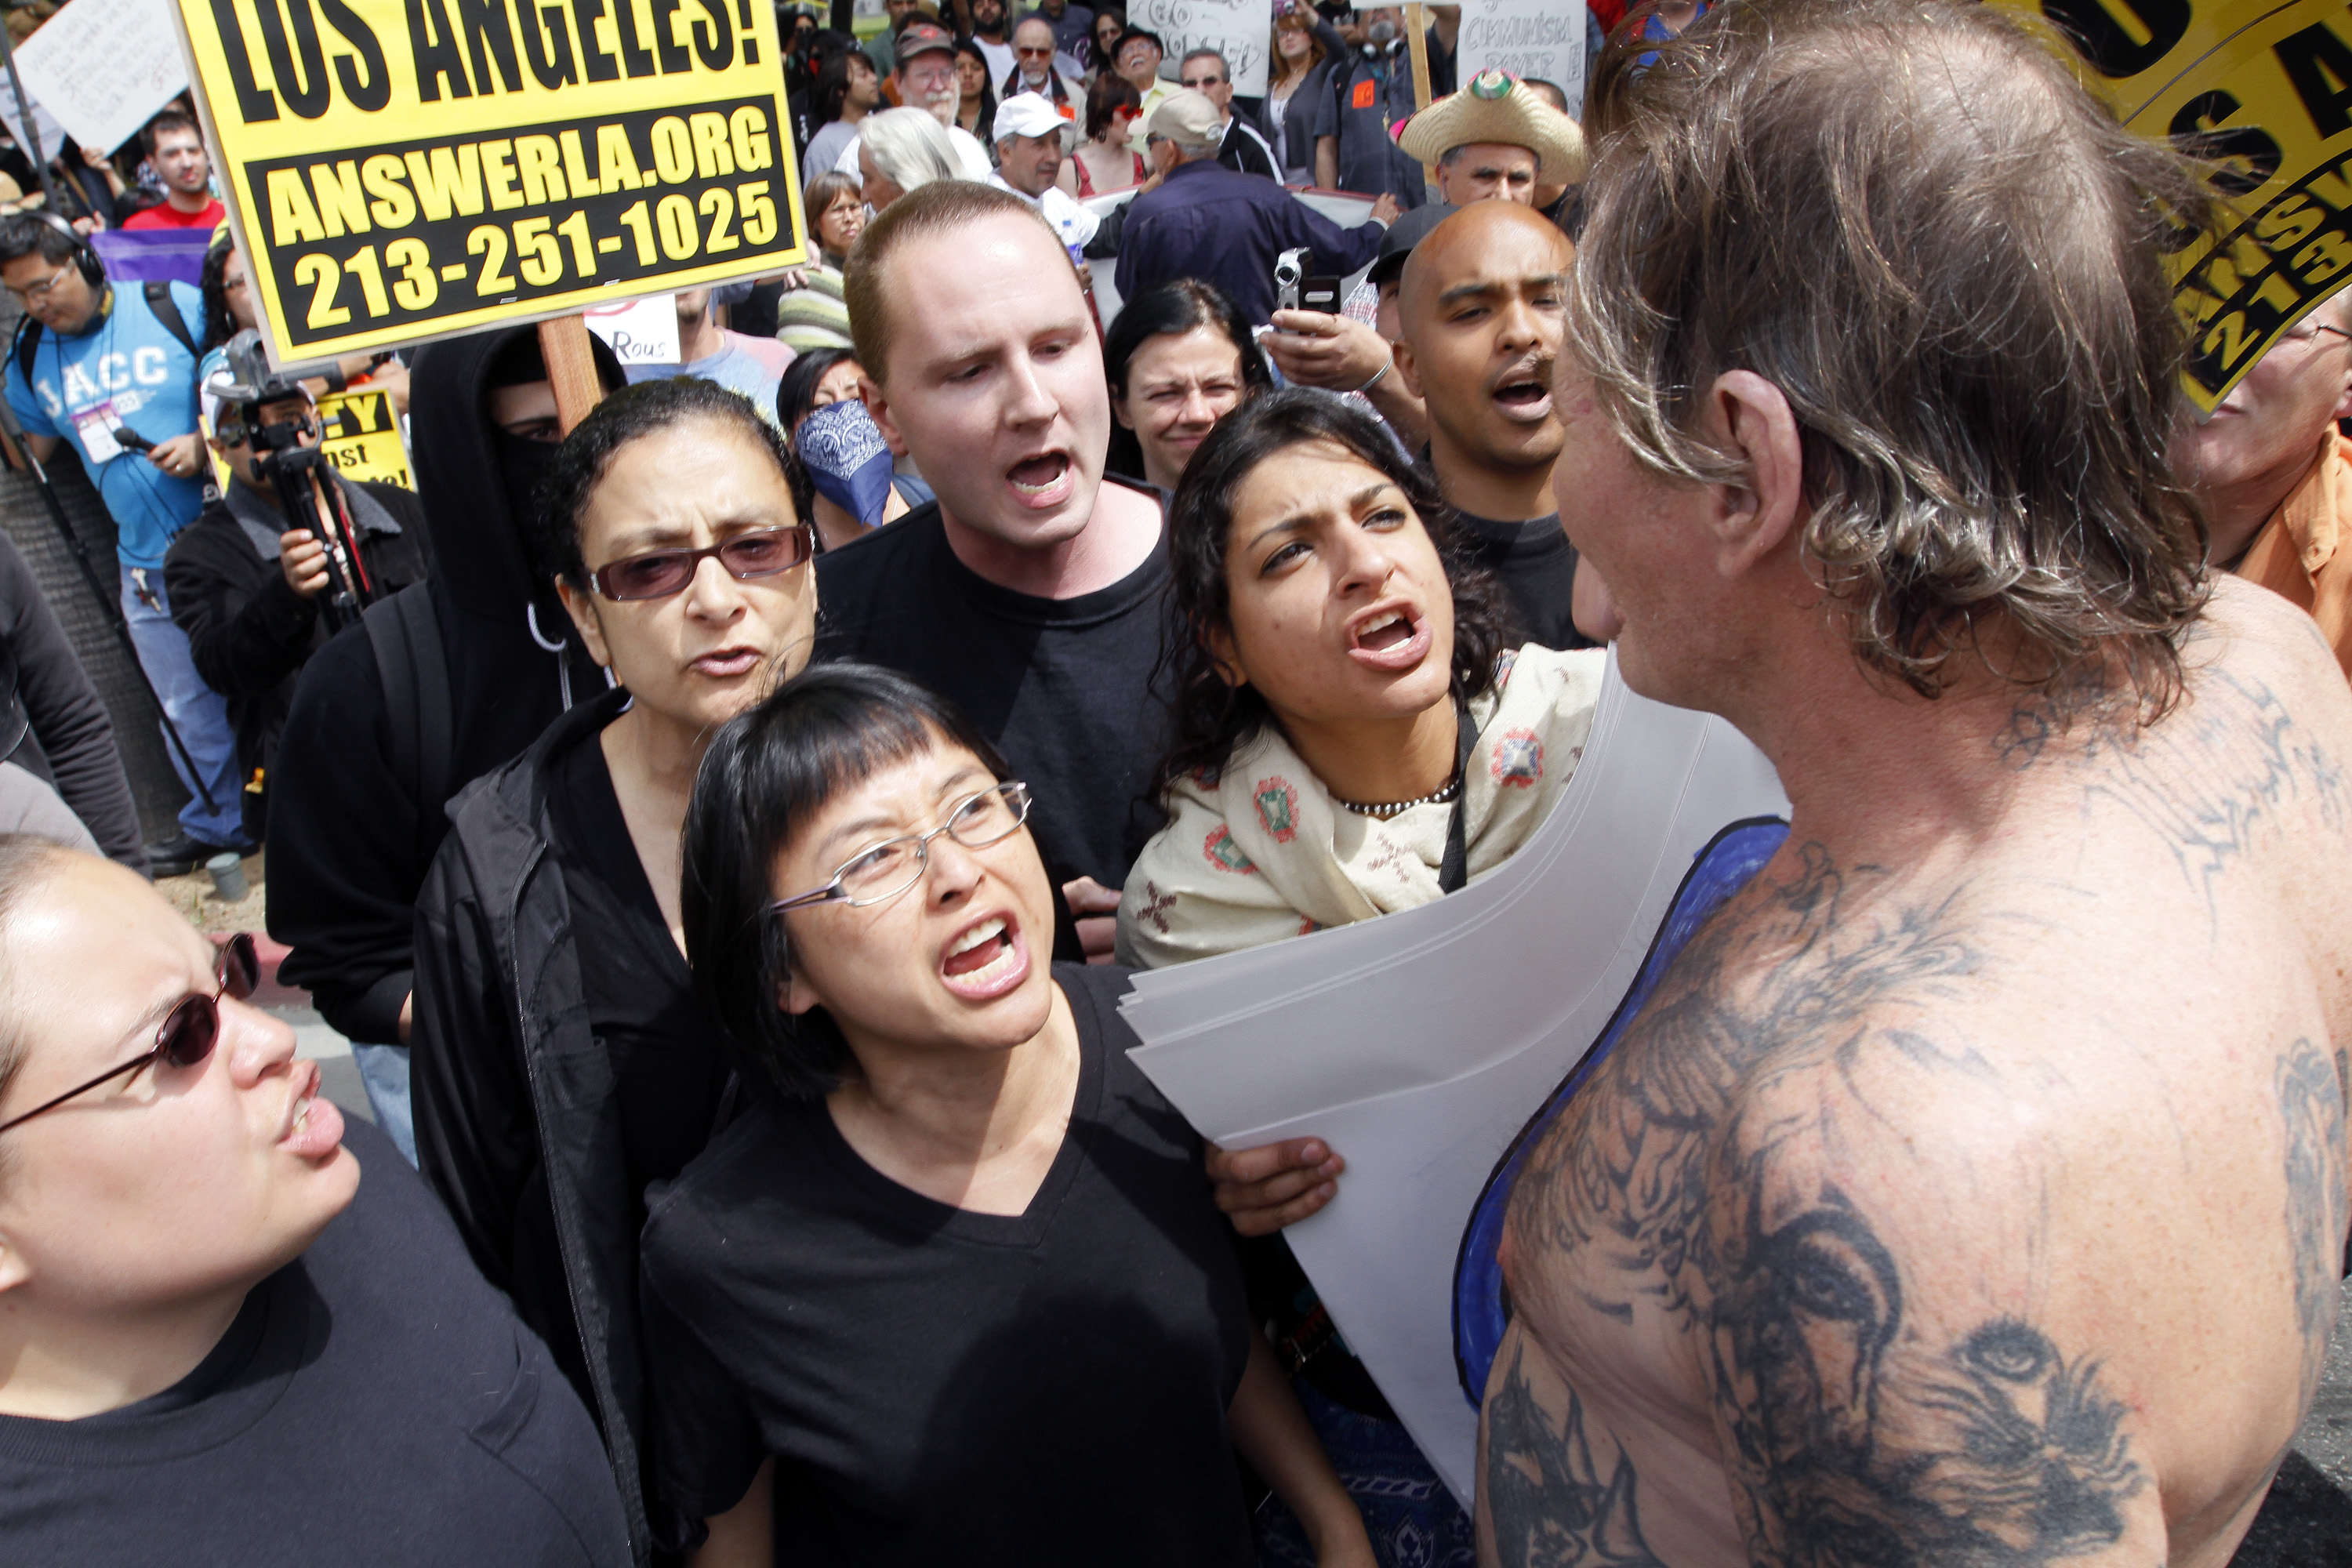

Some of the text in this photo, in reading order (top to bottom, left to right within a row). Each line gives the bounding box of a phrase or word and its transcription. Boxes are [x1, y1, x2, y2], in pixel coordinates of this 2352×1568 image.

[208, 0, 392, 125] LOS
[267, 105, 773, 247] ANSWERLA.ORG
[294, 180, 778, 330] 213-251-1025
